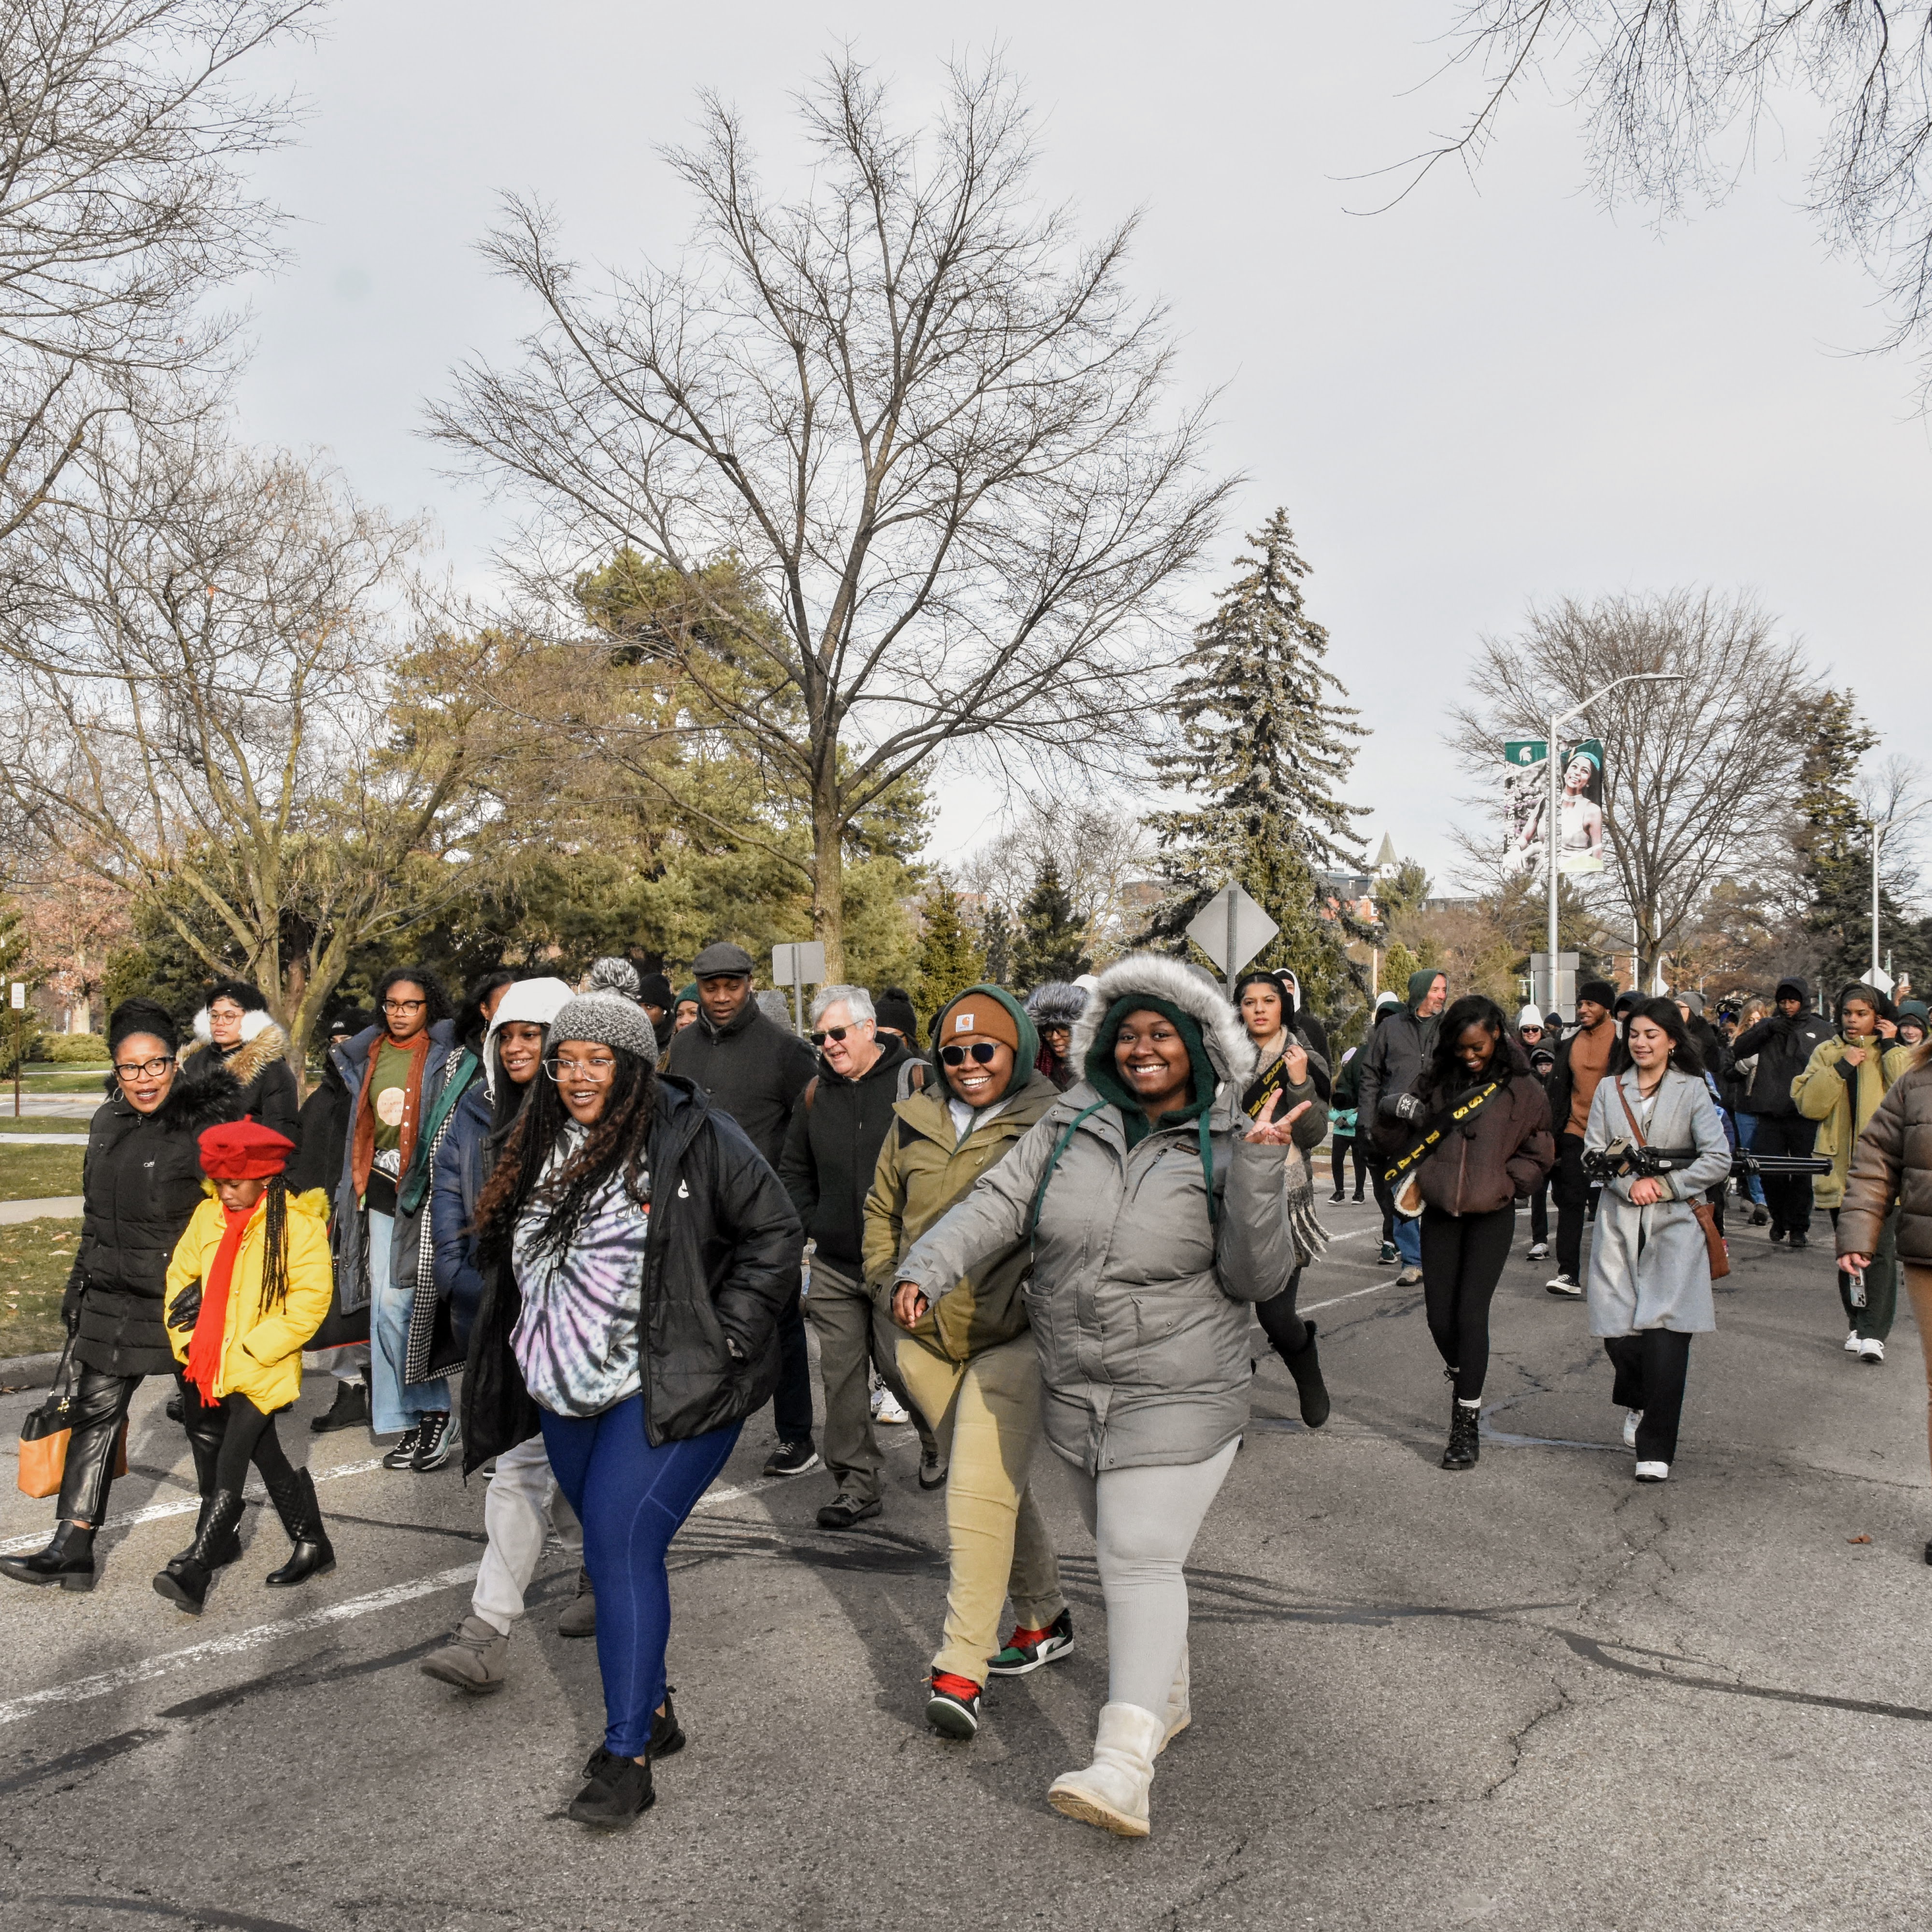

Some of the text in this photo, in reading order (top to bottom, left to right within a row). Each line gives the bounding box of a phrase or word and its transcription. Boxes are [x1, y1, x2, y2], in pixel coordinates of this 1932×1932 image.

[1262, 1058, 1284, 1085] SS
[1248, 1080, 1279, 1118] CON
[1384, 1079, 1503, 1180] ISS BLAC
